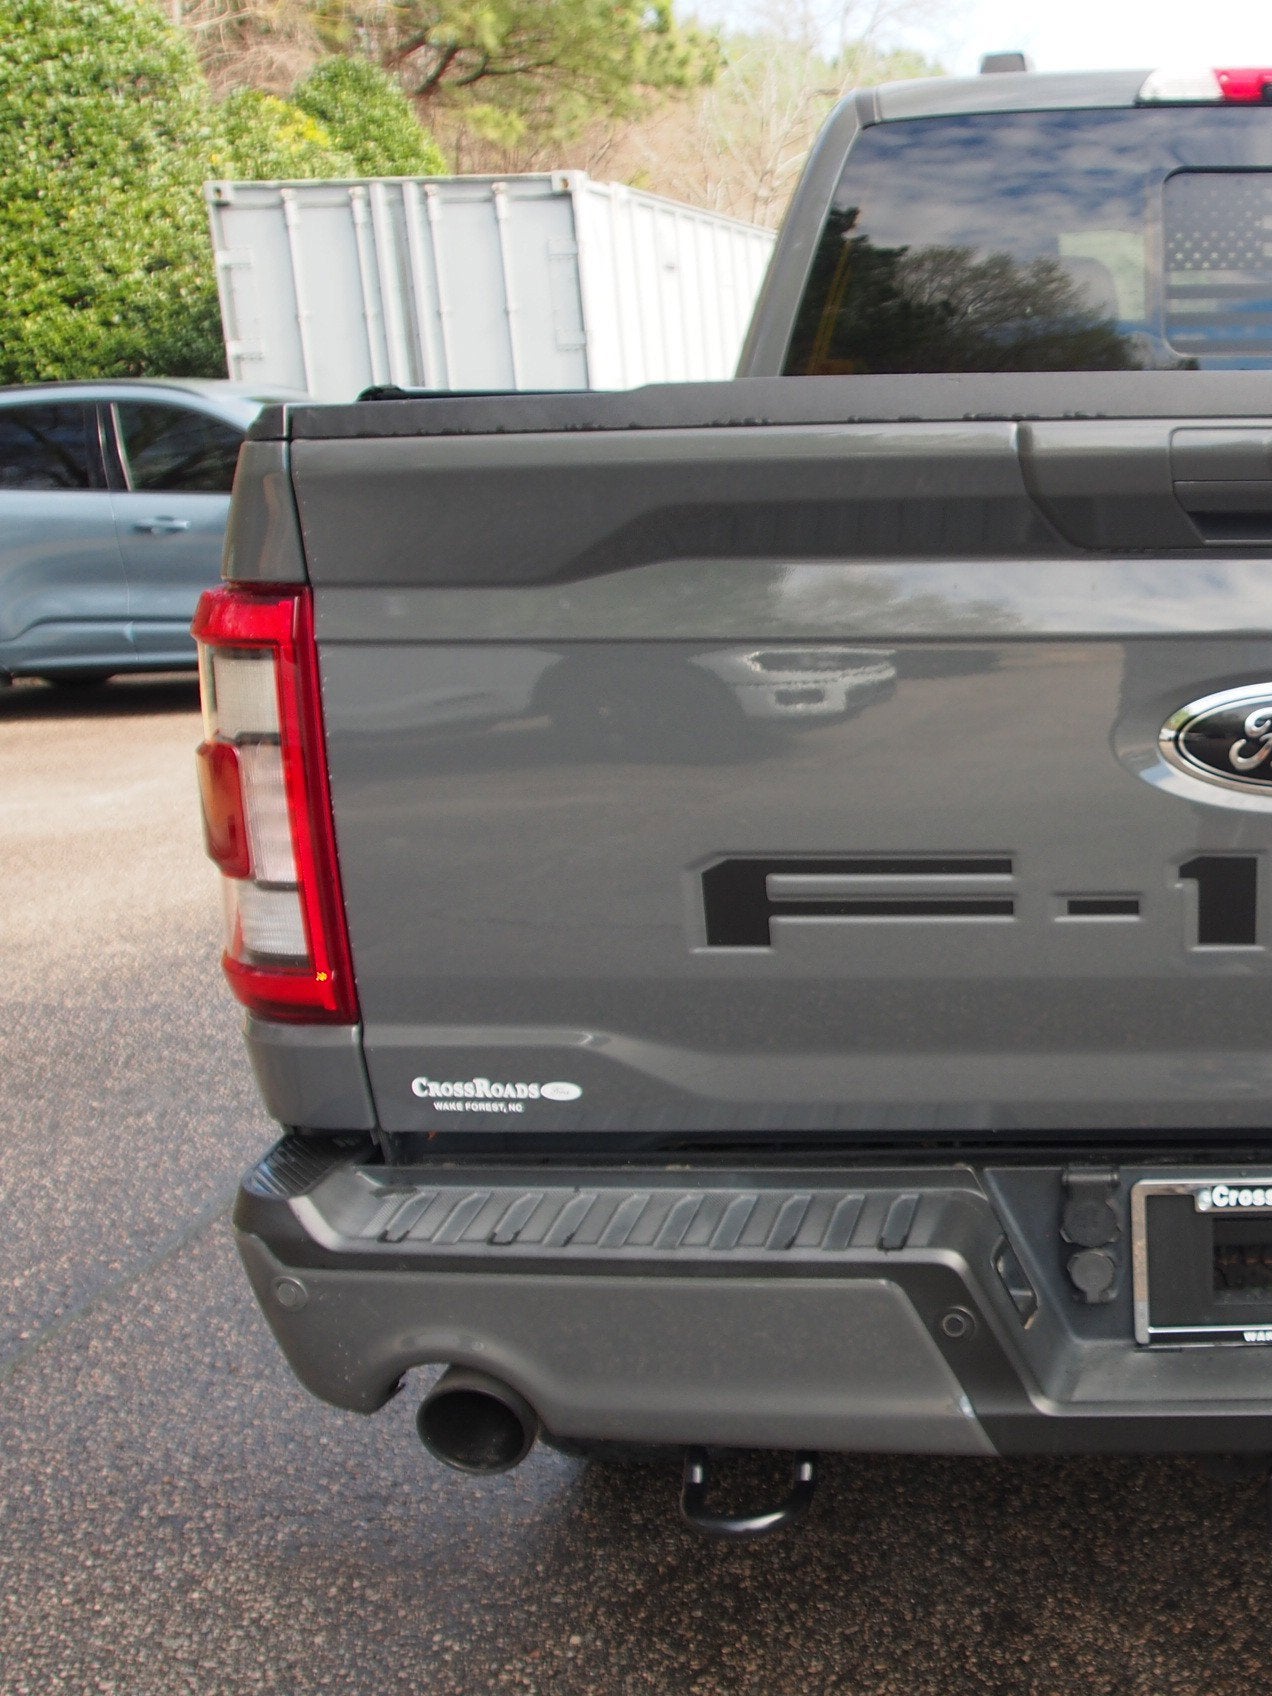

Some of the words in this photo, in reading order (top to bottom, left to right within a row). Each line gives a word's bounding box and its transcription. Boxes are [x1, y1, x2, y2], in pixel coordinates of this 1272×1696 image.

[433, 1101, 463, 1112] WAKE
[465, 1101, 508, 1113] FOREST,
[508, 1102, 524, 1113] NC
